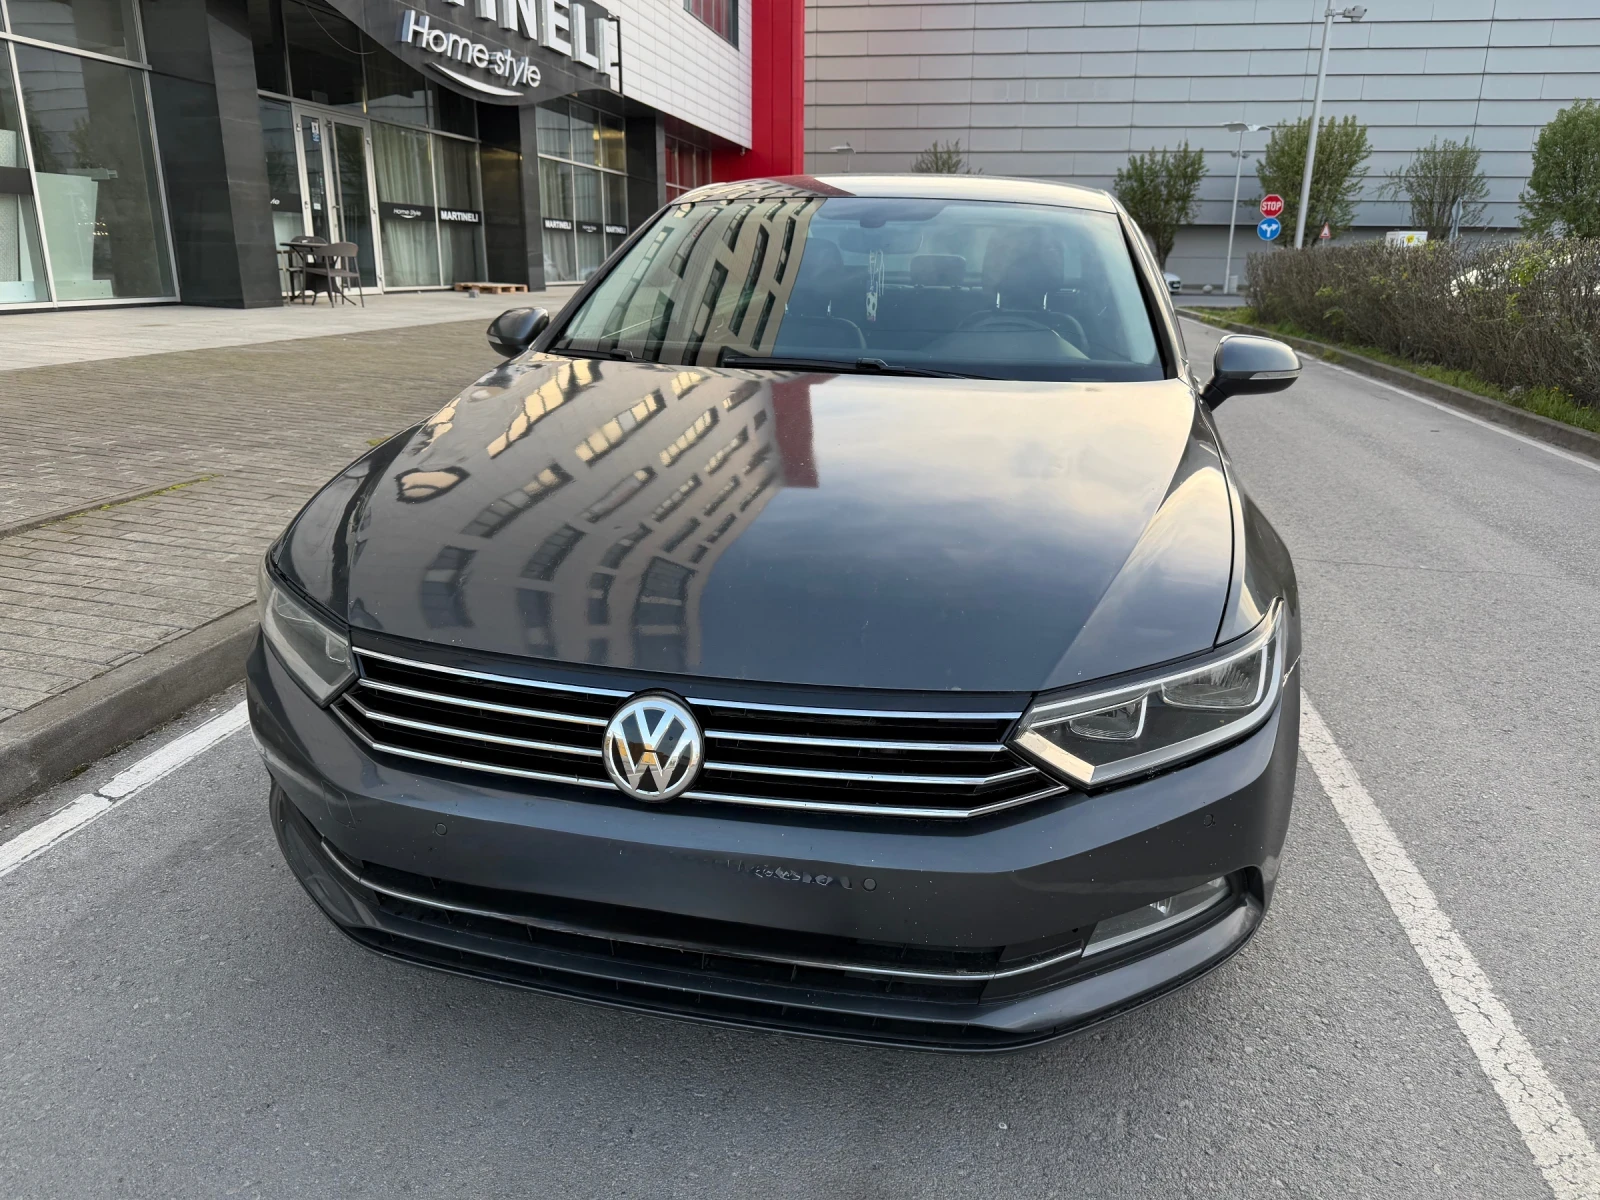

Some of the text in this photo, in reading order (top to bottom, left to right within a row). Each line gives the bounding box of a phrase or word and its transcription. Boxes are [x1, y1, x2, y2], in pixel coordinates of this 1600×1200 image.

[398, 9, 490, 68] Home
[1261, 201, 1282, 211] STOP
[440, 210, 479, 222] MARTINELI
